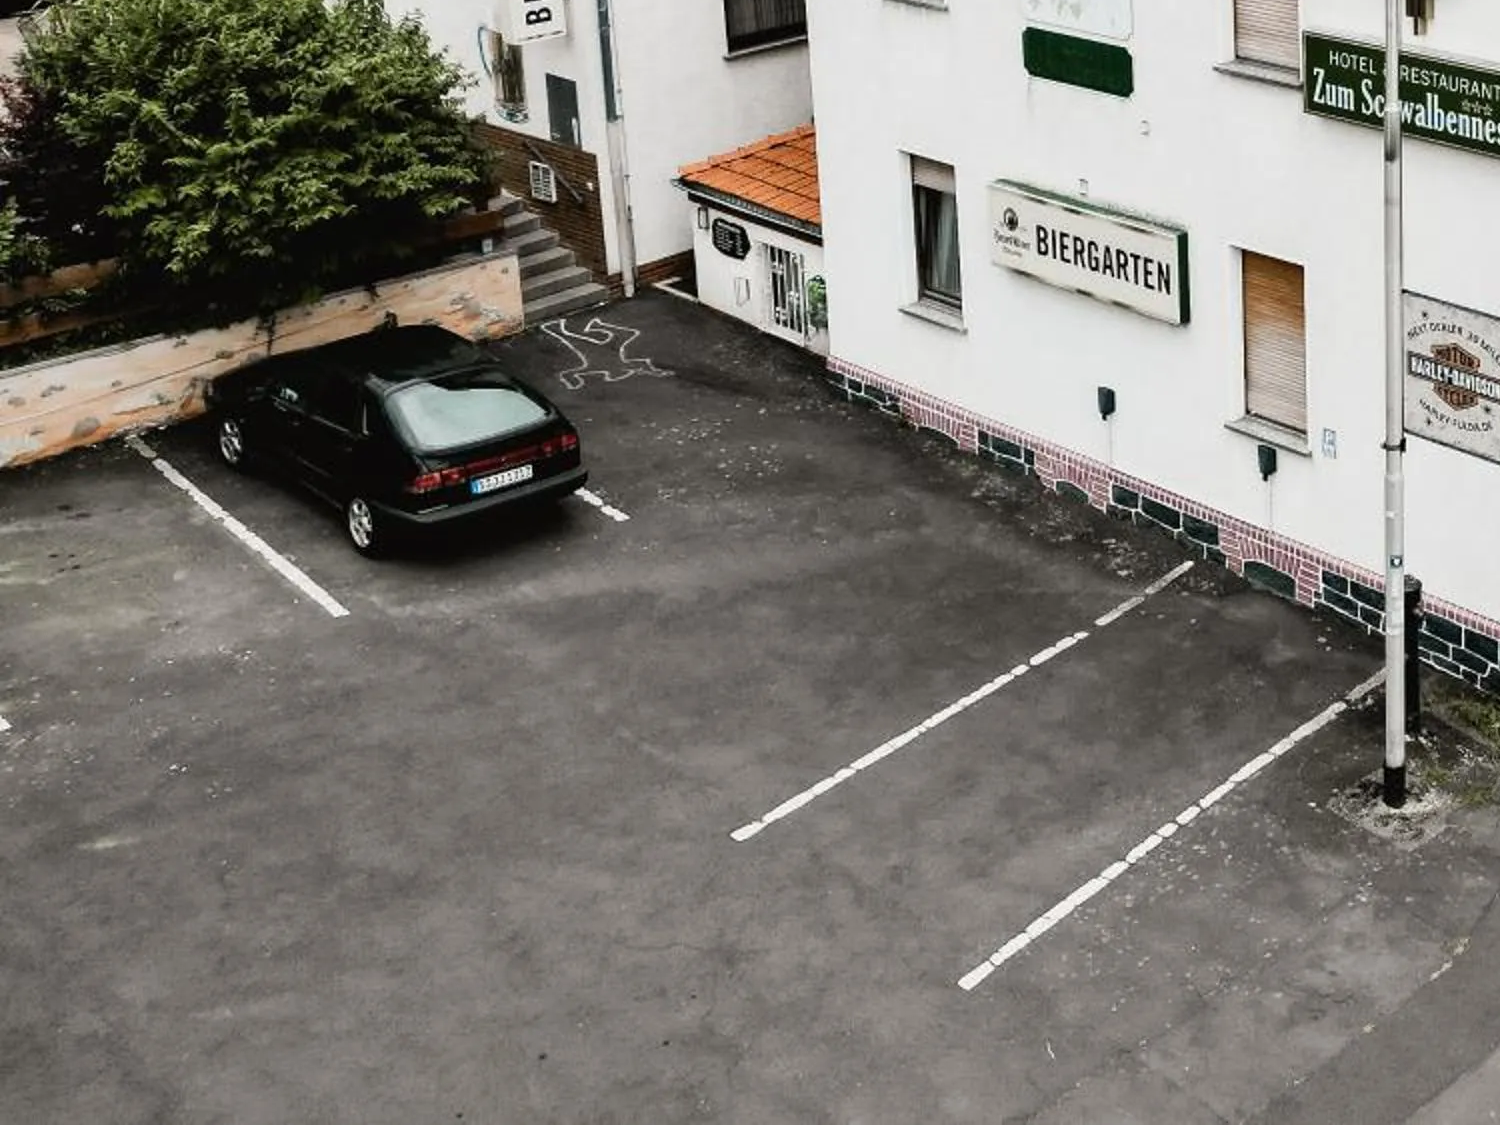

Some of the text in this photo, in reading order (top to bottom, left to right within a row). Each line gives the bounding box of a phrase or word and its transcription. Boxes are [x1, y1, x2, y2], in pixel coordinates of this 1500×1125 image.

[1329, 50, 1377, 75] HOTEL
[1313, 67, 1355, 112] Zum
[1035, 224, 1172, 296] BIERGARTEN
